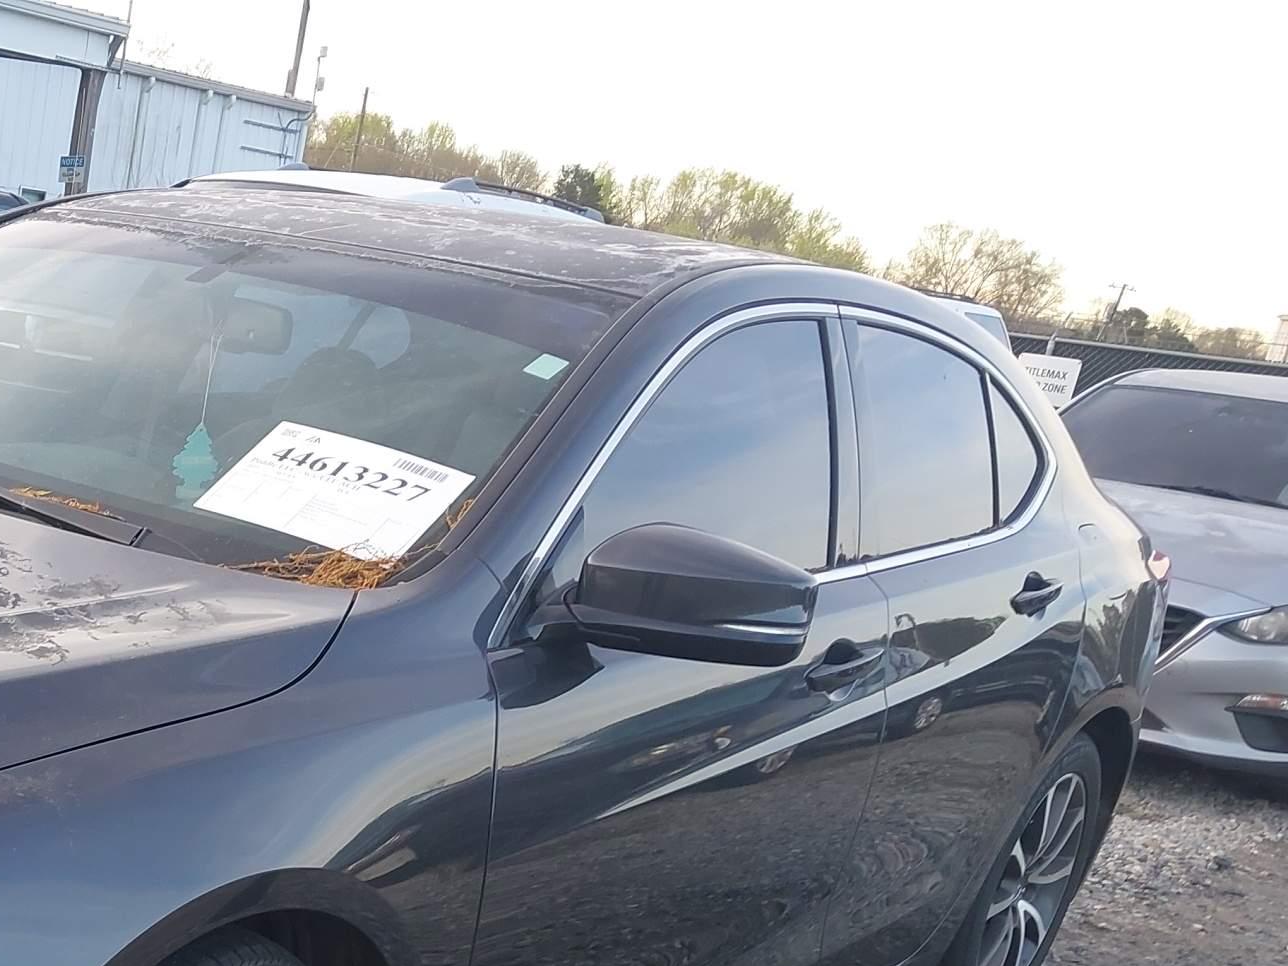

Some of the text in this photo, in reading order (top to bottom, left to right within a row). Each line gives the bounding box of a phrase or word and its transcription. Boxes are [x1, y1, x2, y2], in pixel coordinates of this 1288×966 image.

[62, 158, 83, 166] NOTICE
[1041, 383, 1067, 393] ZONE
[272, 447, 431, 501] 44613227
